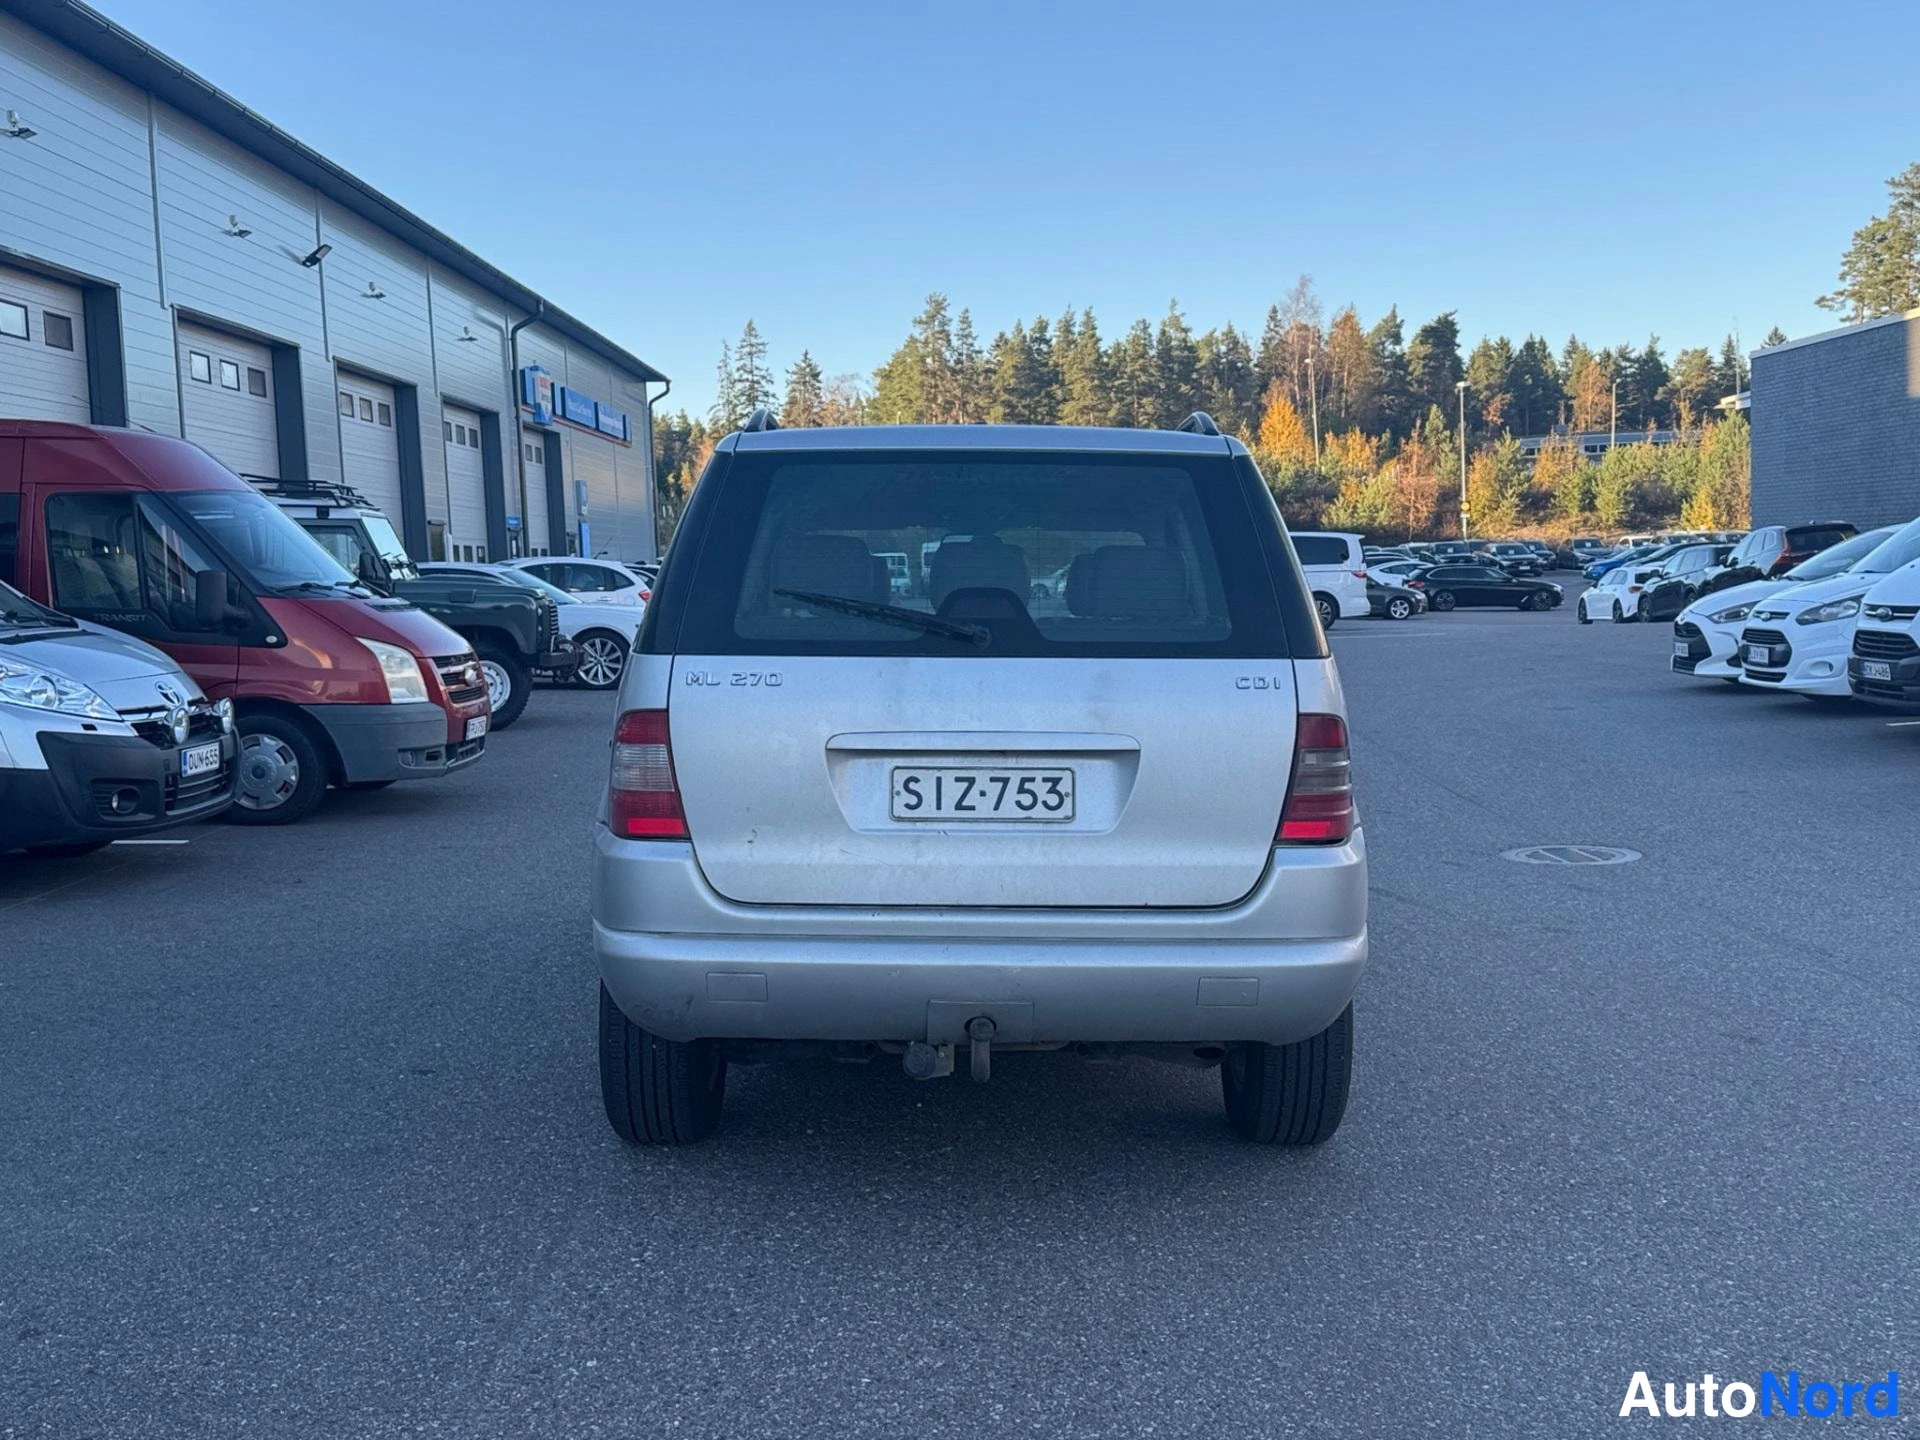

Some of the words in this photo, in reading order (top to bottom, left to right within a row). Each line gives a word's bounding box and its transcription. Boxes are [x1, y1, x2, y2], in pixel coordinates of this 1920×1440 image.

[686, 671, 720, 686] ML
[730, 671, 783, 687] 270
[1235, 675, 1281, 690] CDI
